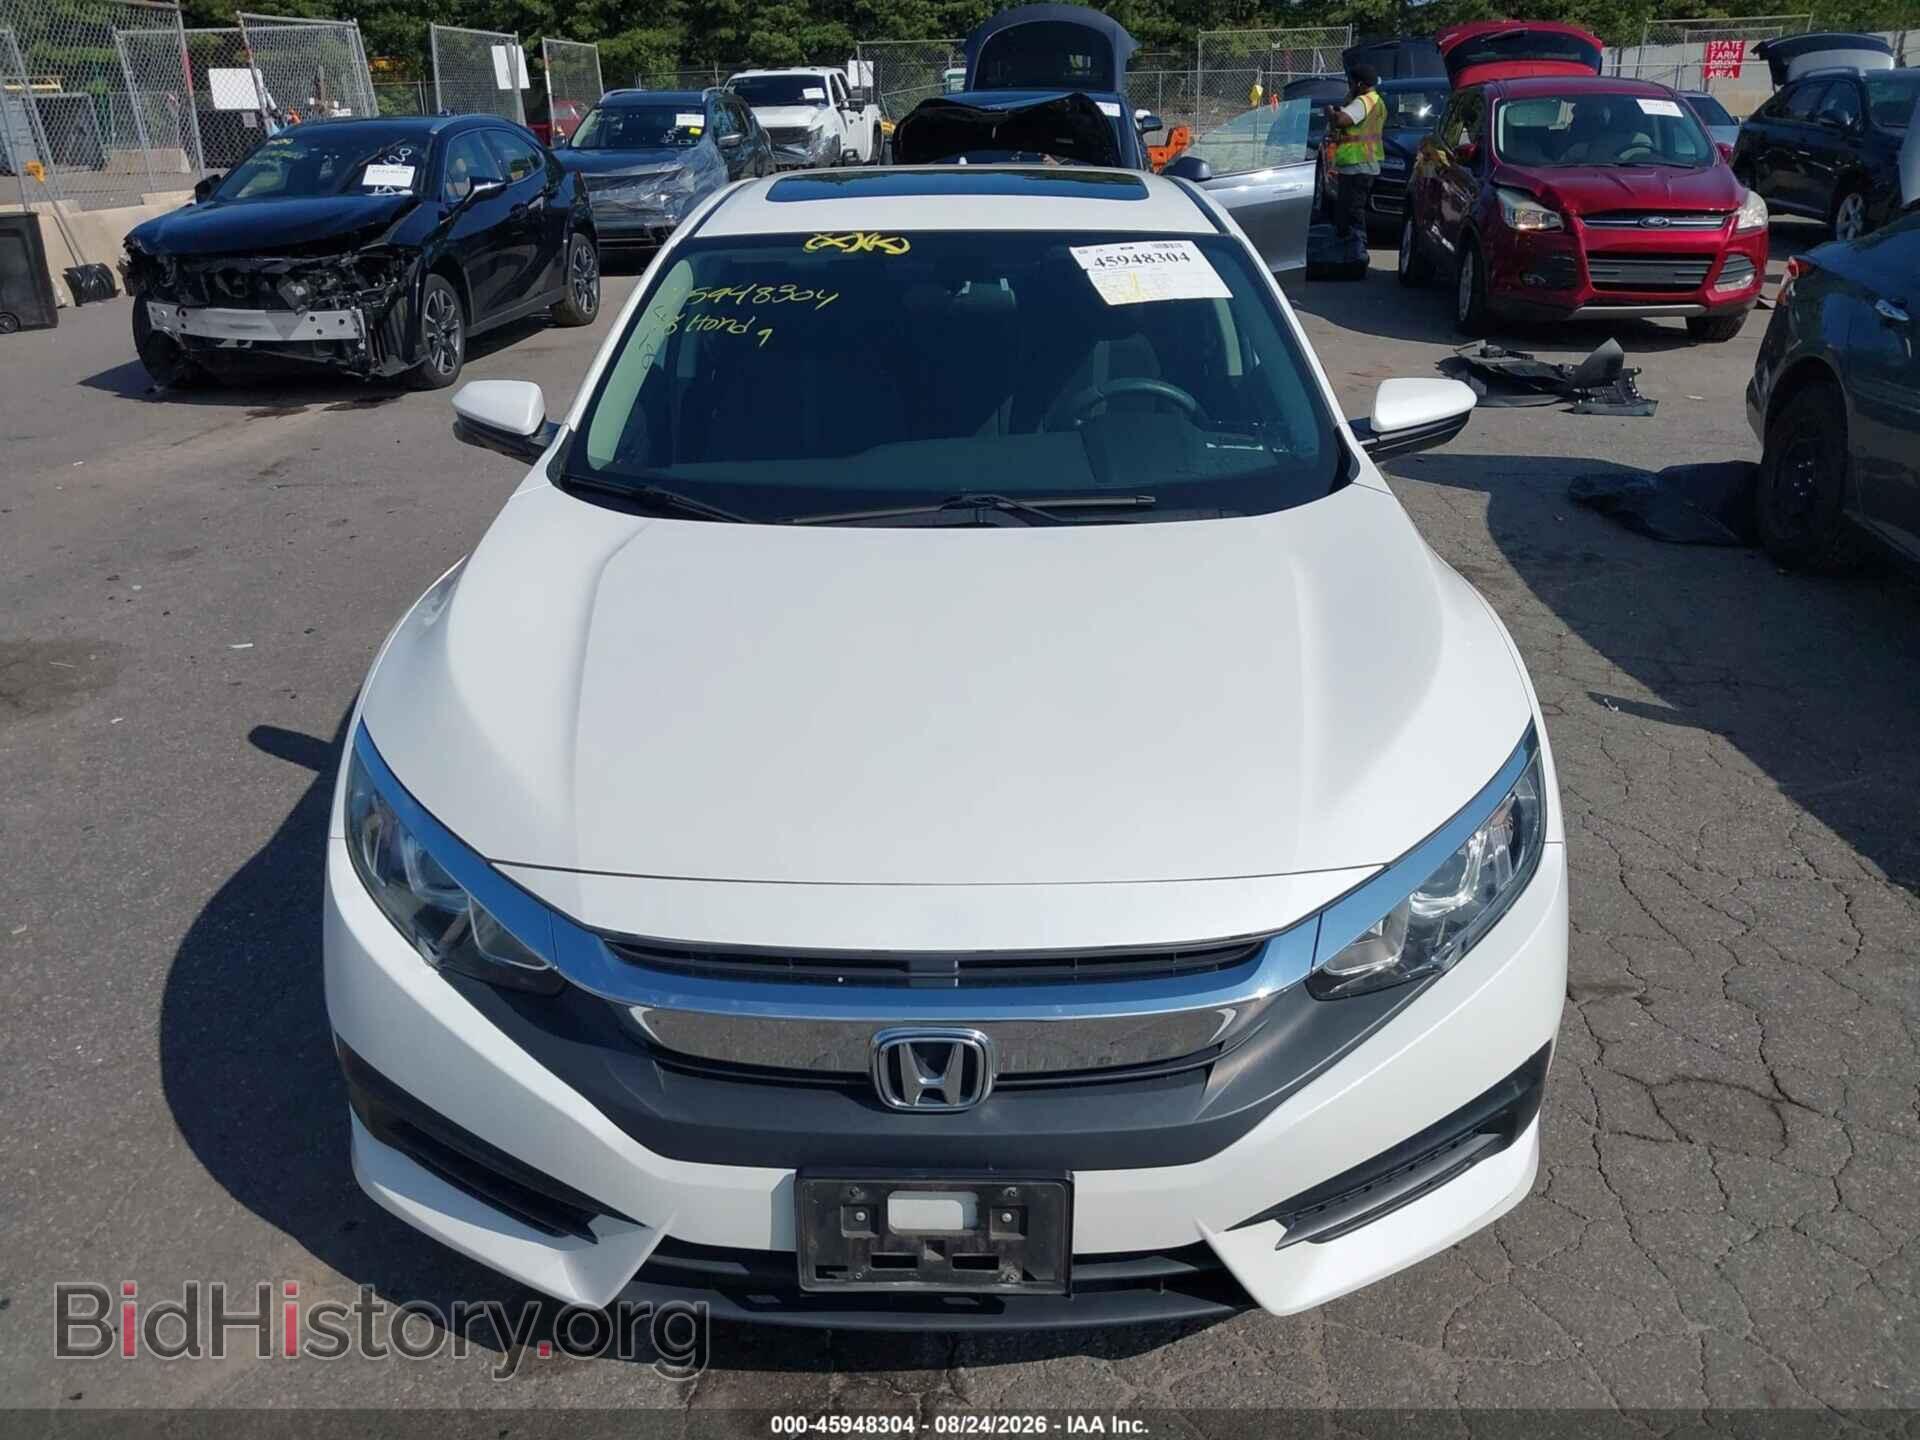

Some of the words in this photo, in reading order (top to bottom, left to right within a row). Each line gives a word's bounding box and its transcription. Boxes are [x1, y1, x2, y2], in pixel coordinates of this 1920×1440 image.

[1710, 41, 1743, 50] STATE
[1710, 51, 1739, 60] FARM
[1708, 69, 1735, 80] AREA
[1094, 252, 1191, 268] 45948304
